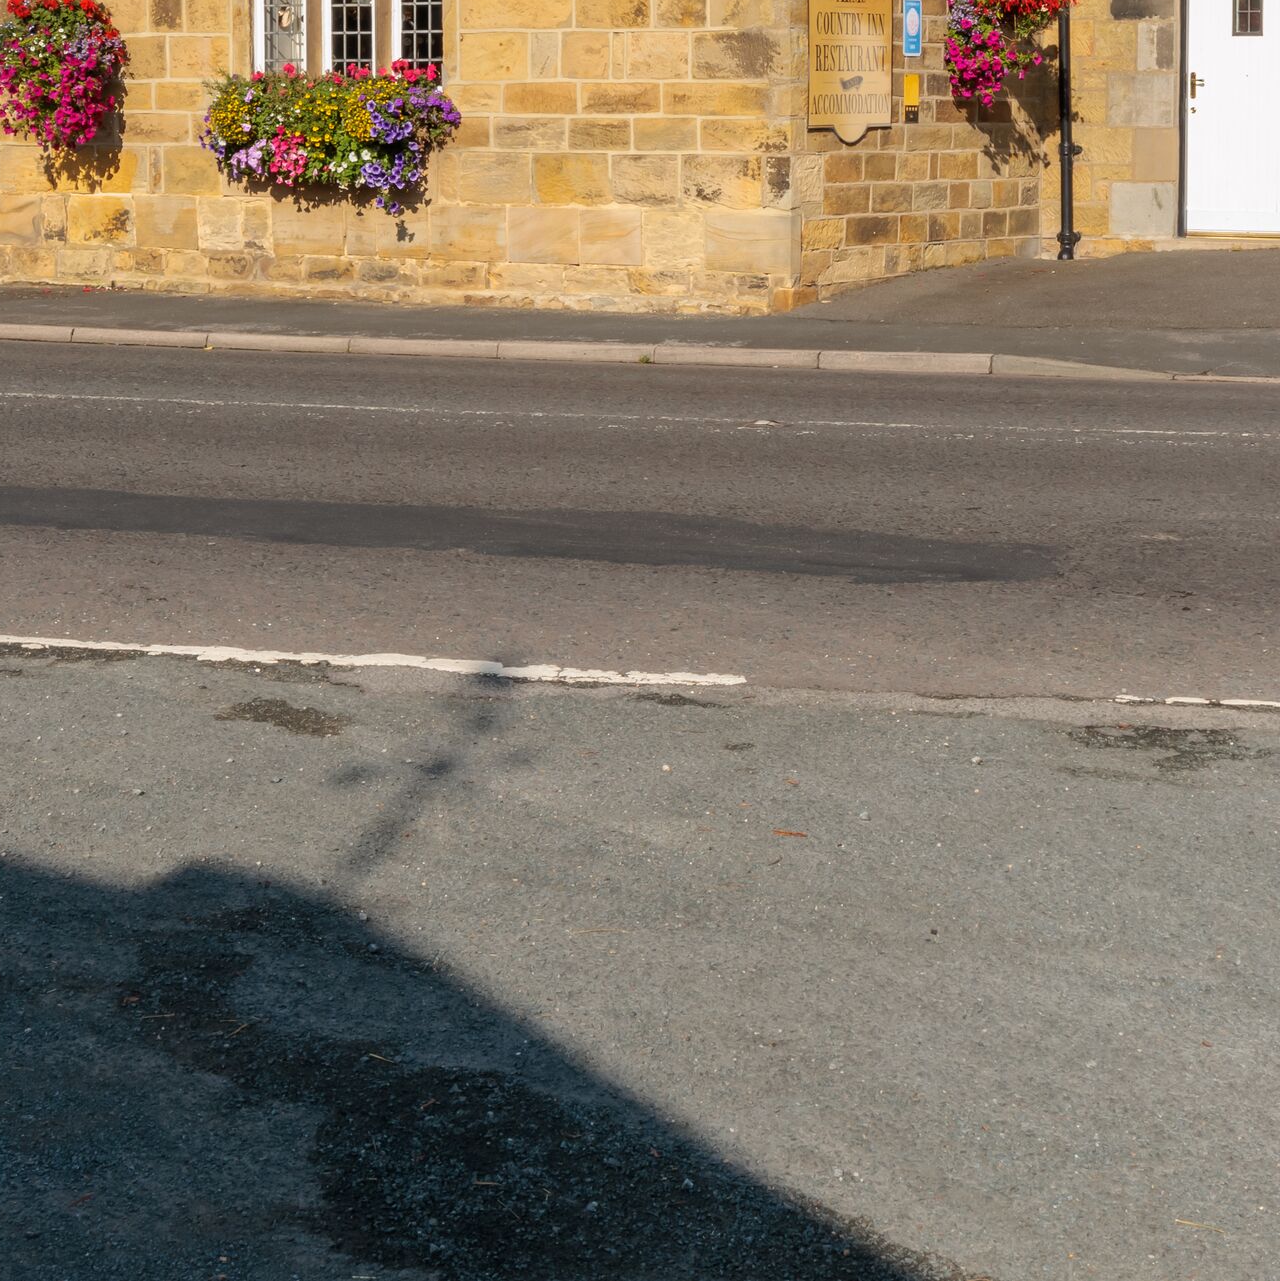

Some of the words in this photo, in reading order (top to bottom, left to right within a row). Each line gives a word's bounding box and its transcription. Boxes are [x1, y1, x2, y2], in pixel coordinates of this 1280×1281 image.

[816, 11, 863, 36] COUNTRY
[867, 13, 885, 36] INN
[815, 44, 887, 72] RESTAURANT
[811, 93, 889, 115] ACCOMMODATION
